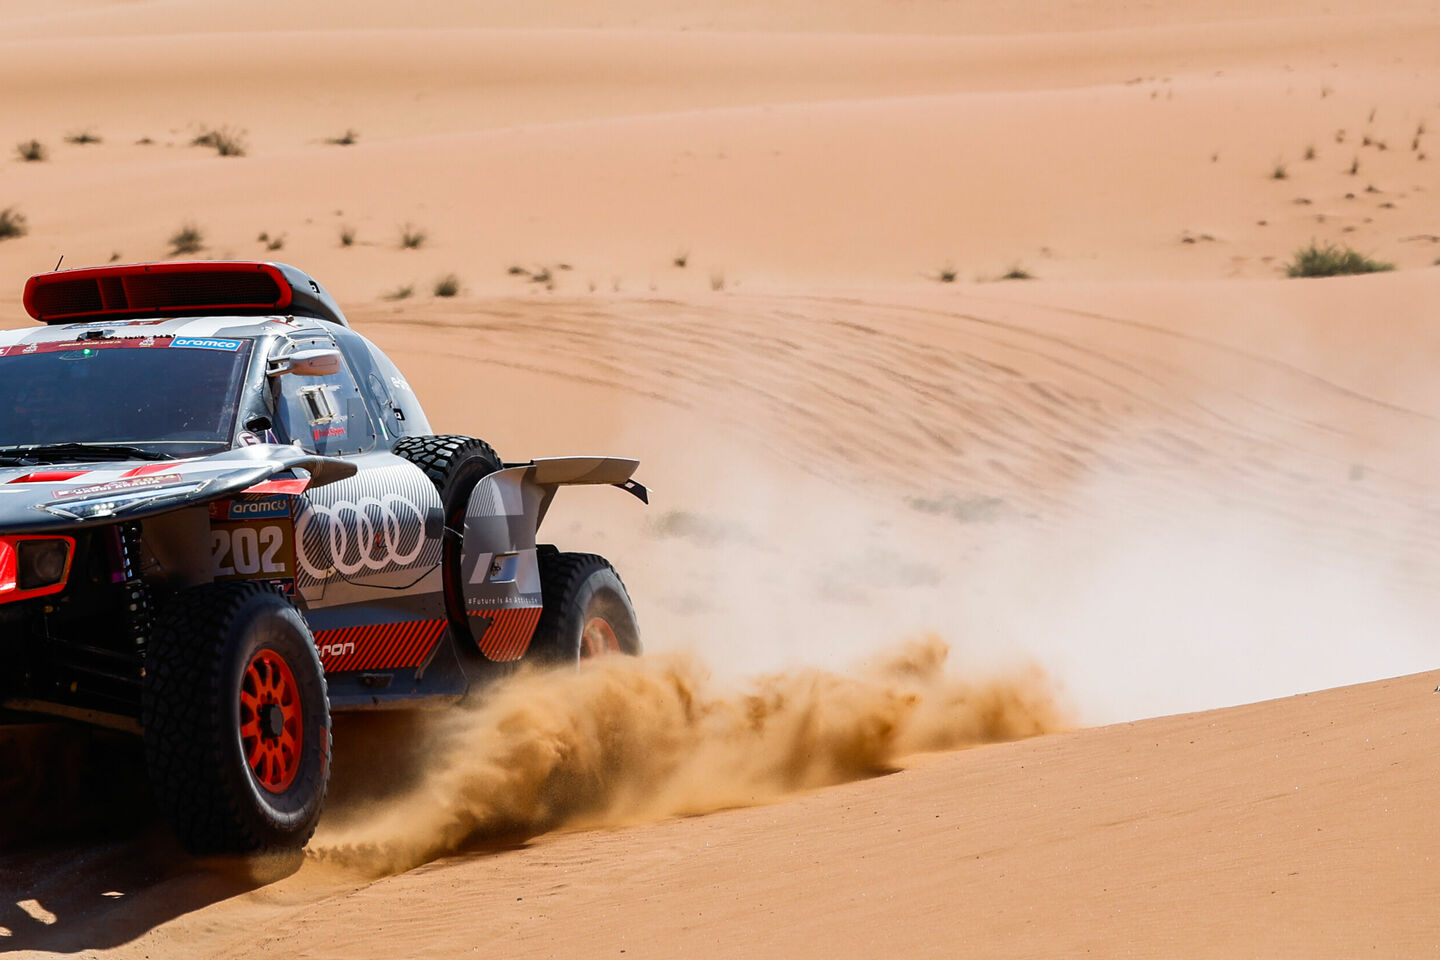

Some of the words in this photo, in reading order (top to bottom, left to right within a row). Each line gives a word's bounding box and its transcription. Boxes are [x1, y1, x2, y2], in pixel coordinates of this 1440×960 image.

[176, 339, 236, 348] aramco
[232, 500, 287, 514] aramco
[211, 525, 286, 576] 202
